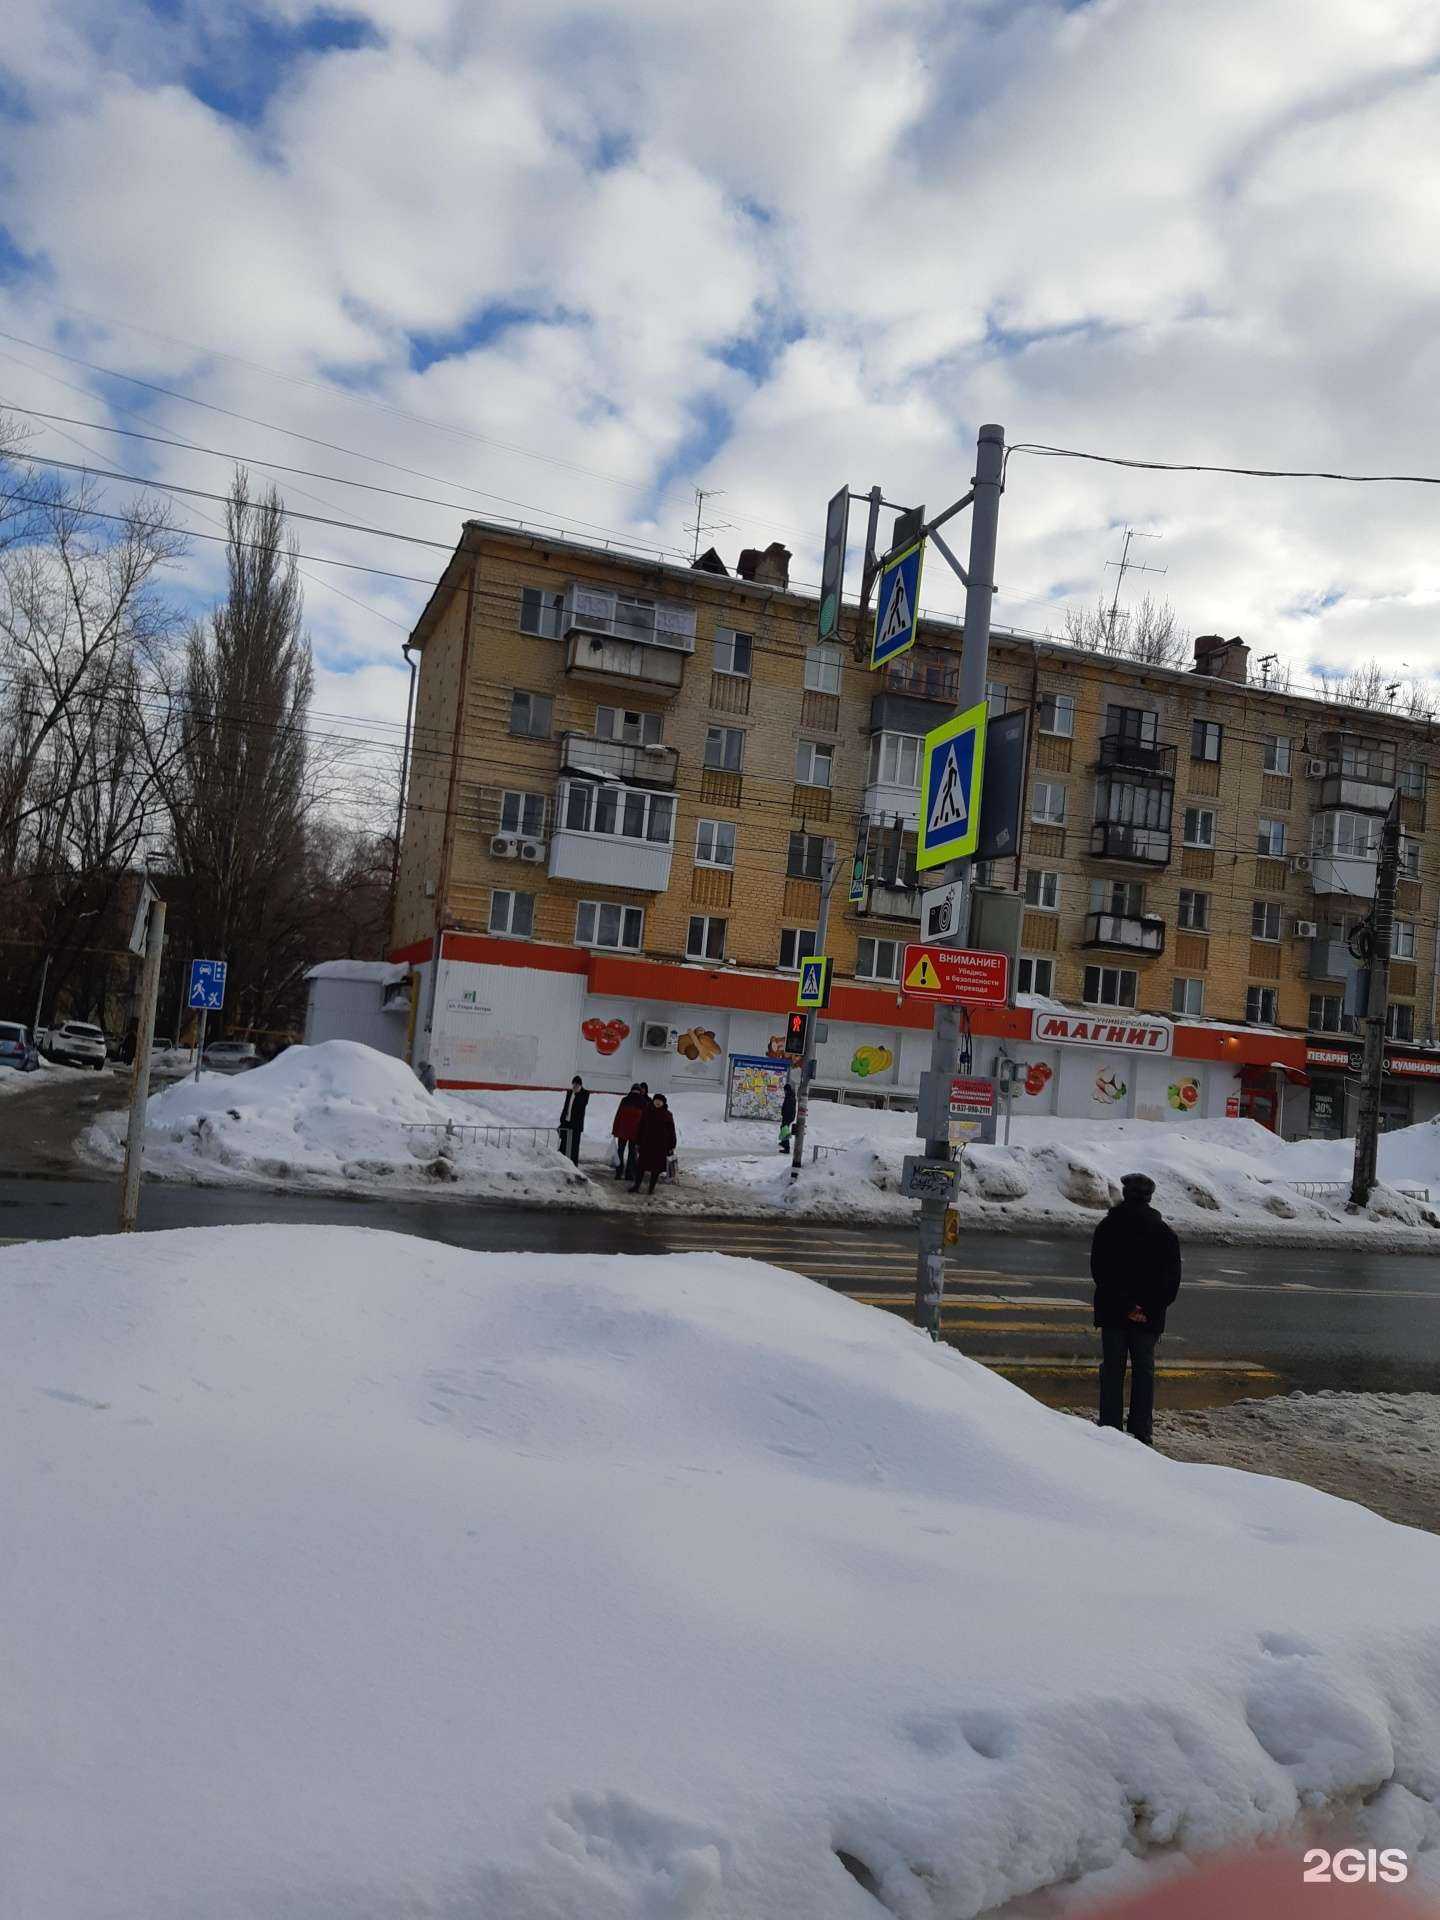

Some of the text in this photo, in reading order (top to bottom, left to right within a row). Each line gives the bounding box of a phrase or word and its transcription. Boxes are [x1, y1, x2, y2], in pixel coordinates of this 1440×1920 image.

[939, 953, 1001, 969] ВНИМАНИЕ!
[951, 974, 999, 987] безопасности
[1042, 1018, 1164, 1047] МАГНИТ
[1306, 1051, 1349, 1064] ПЕКАРНЯ
